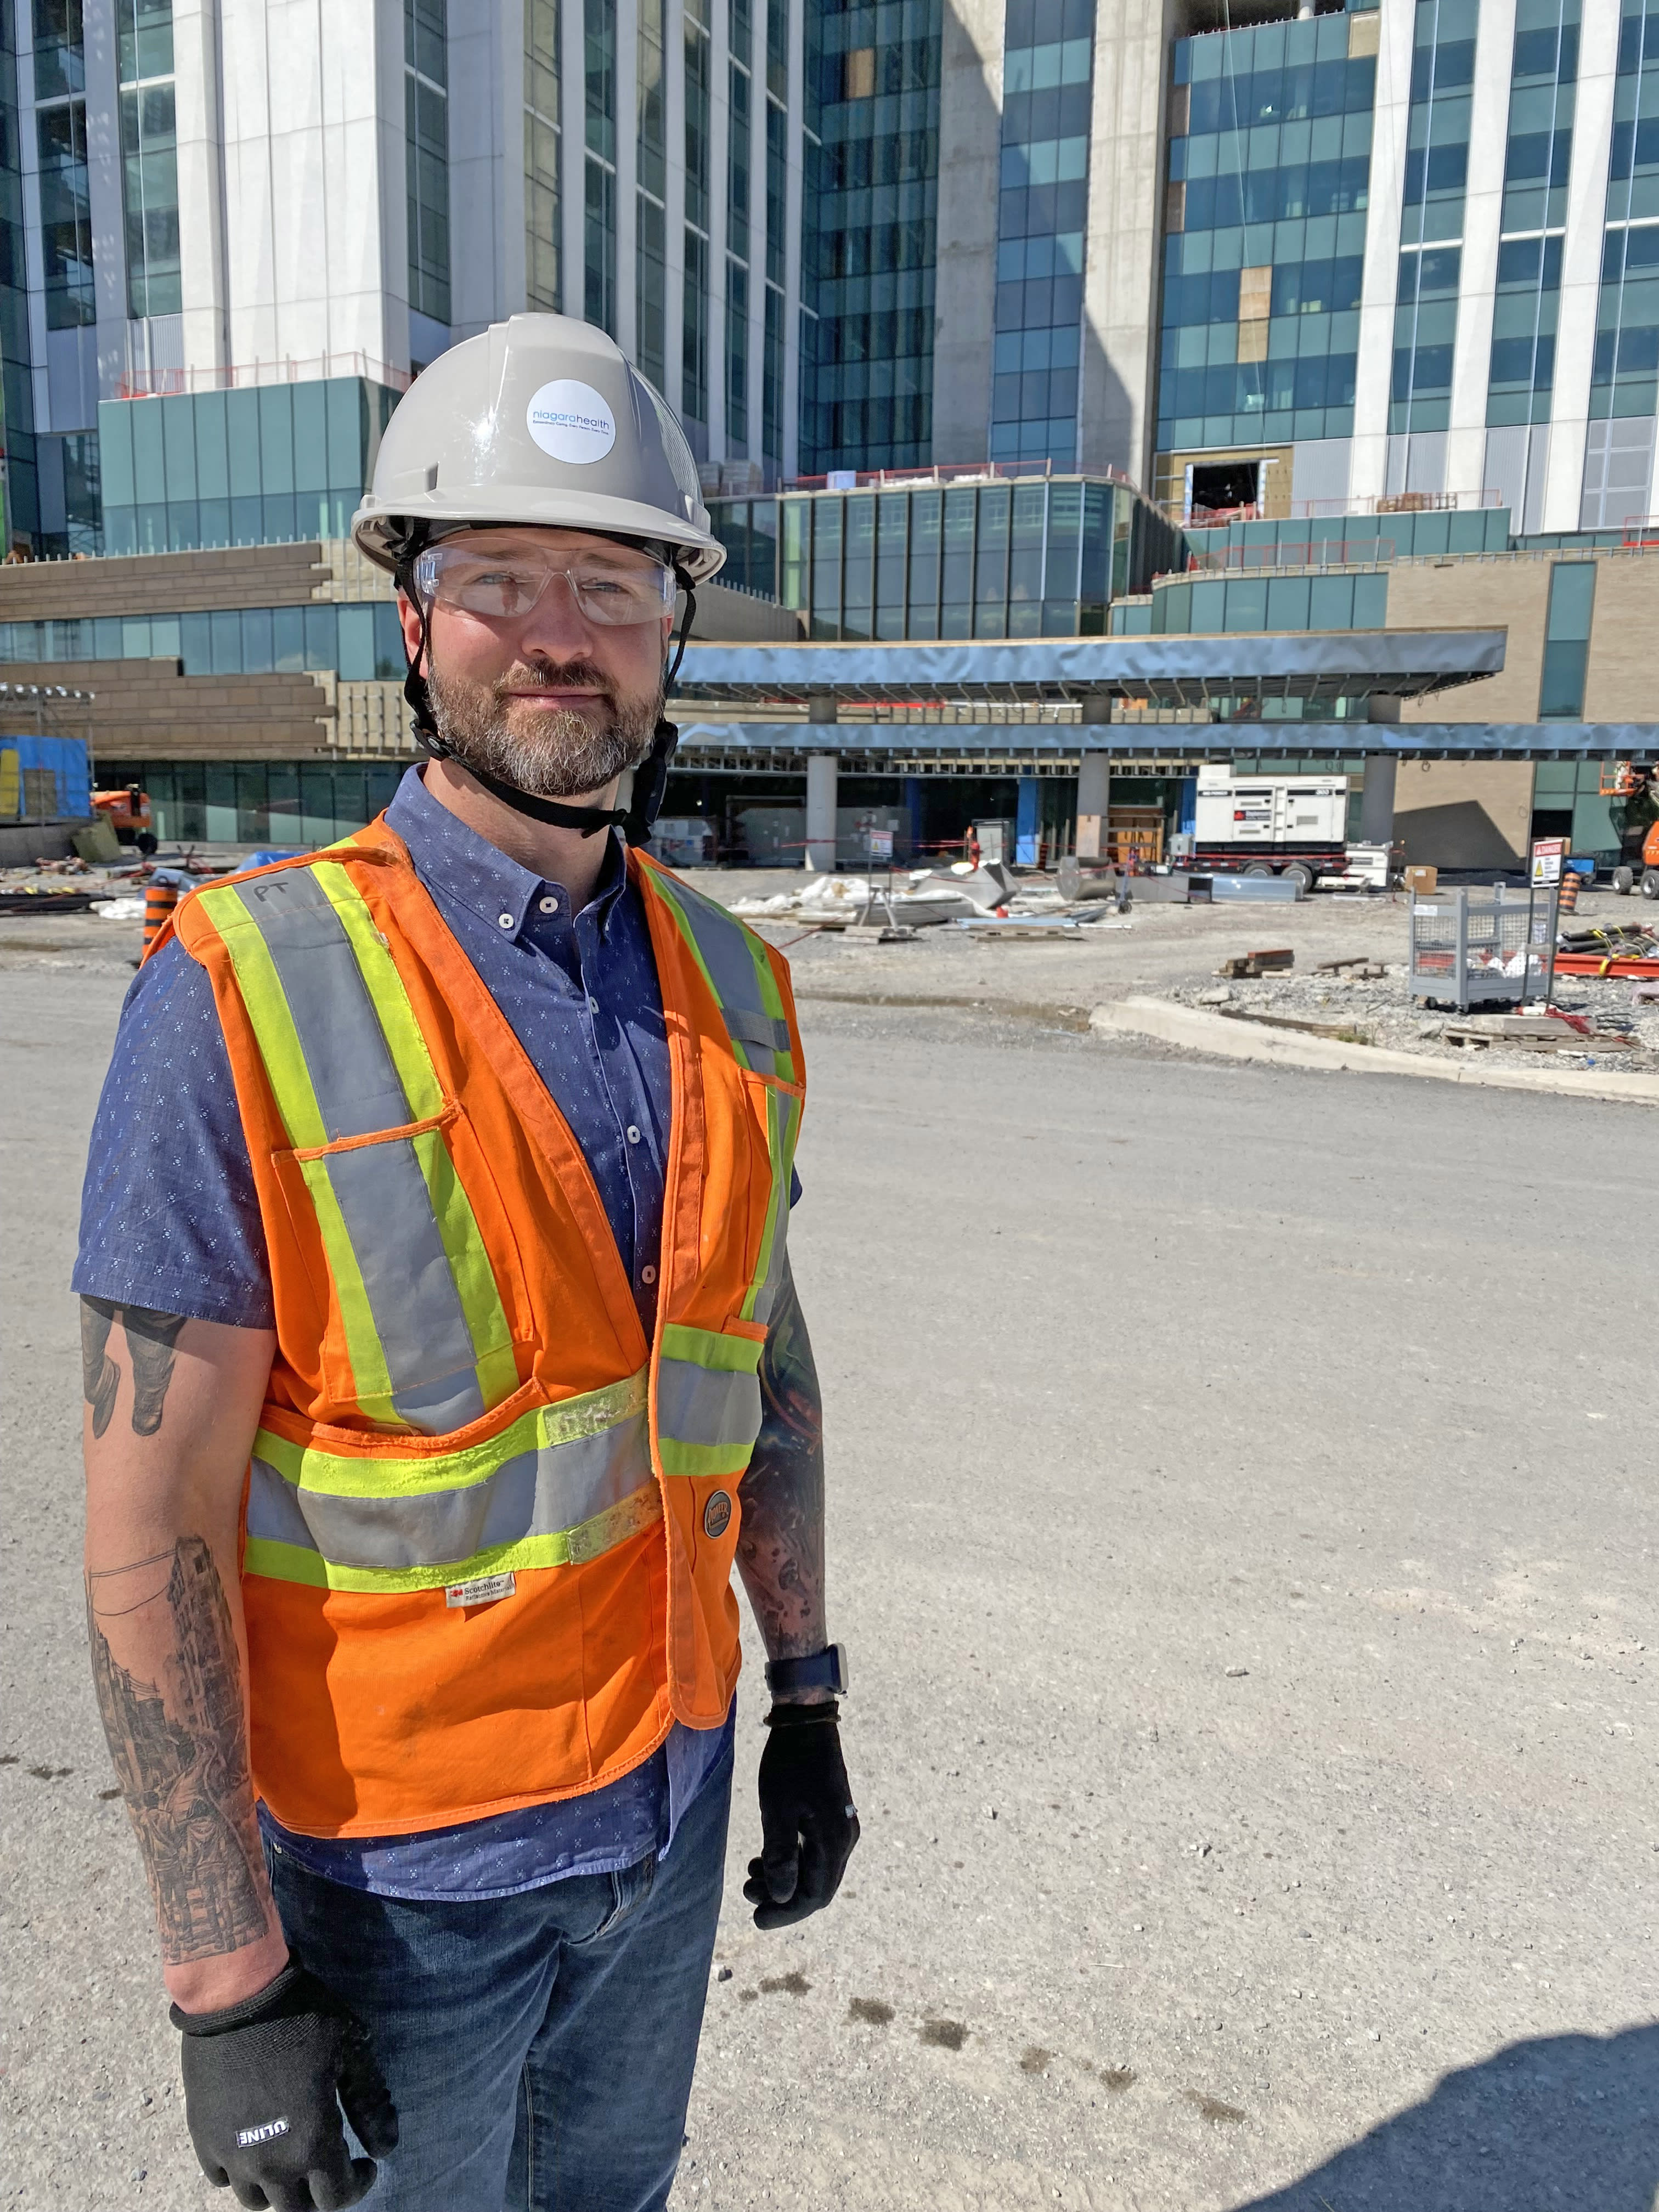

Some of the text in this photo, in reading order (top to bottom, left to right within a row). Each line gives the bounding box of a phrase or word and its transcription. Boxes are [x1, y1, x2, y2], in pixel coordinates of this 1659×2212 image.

[533, 410, 610, 430] niagarahealth
[253, 882, 289, 902] PT
[239, 2121, 286, 2144] ULINE
